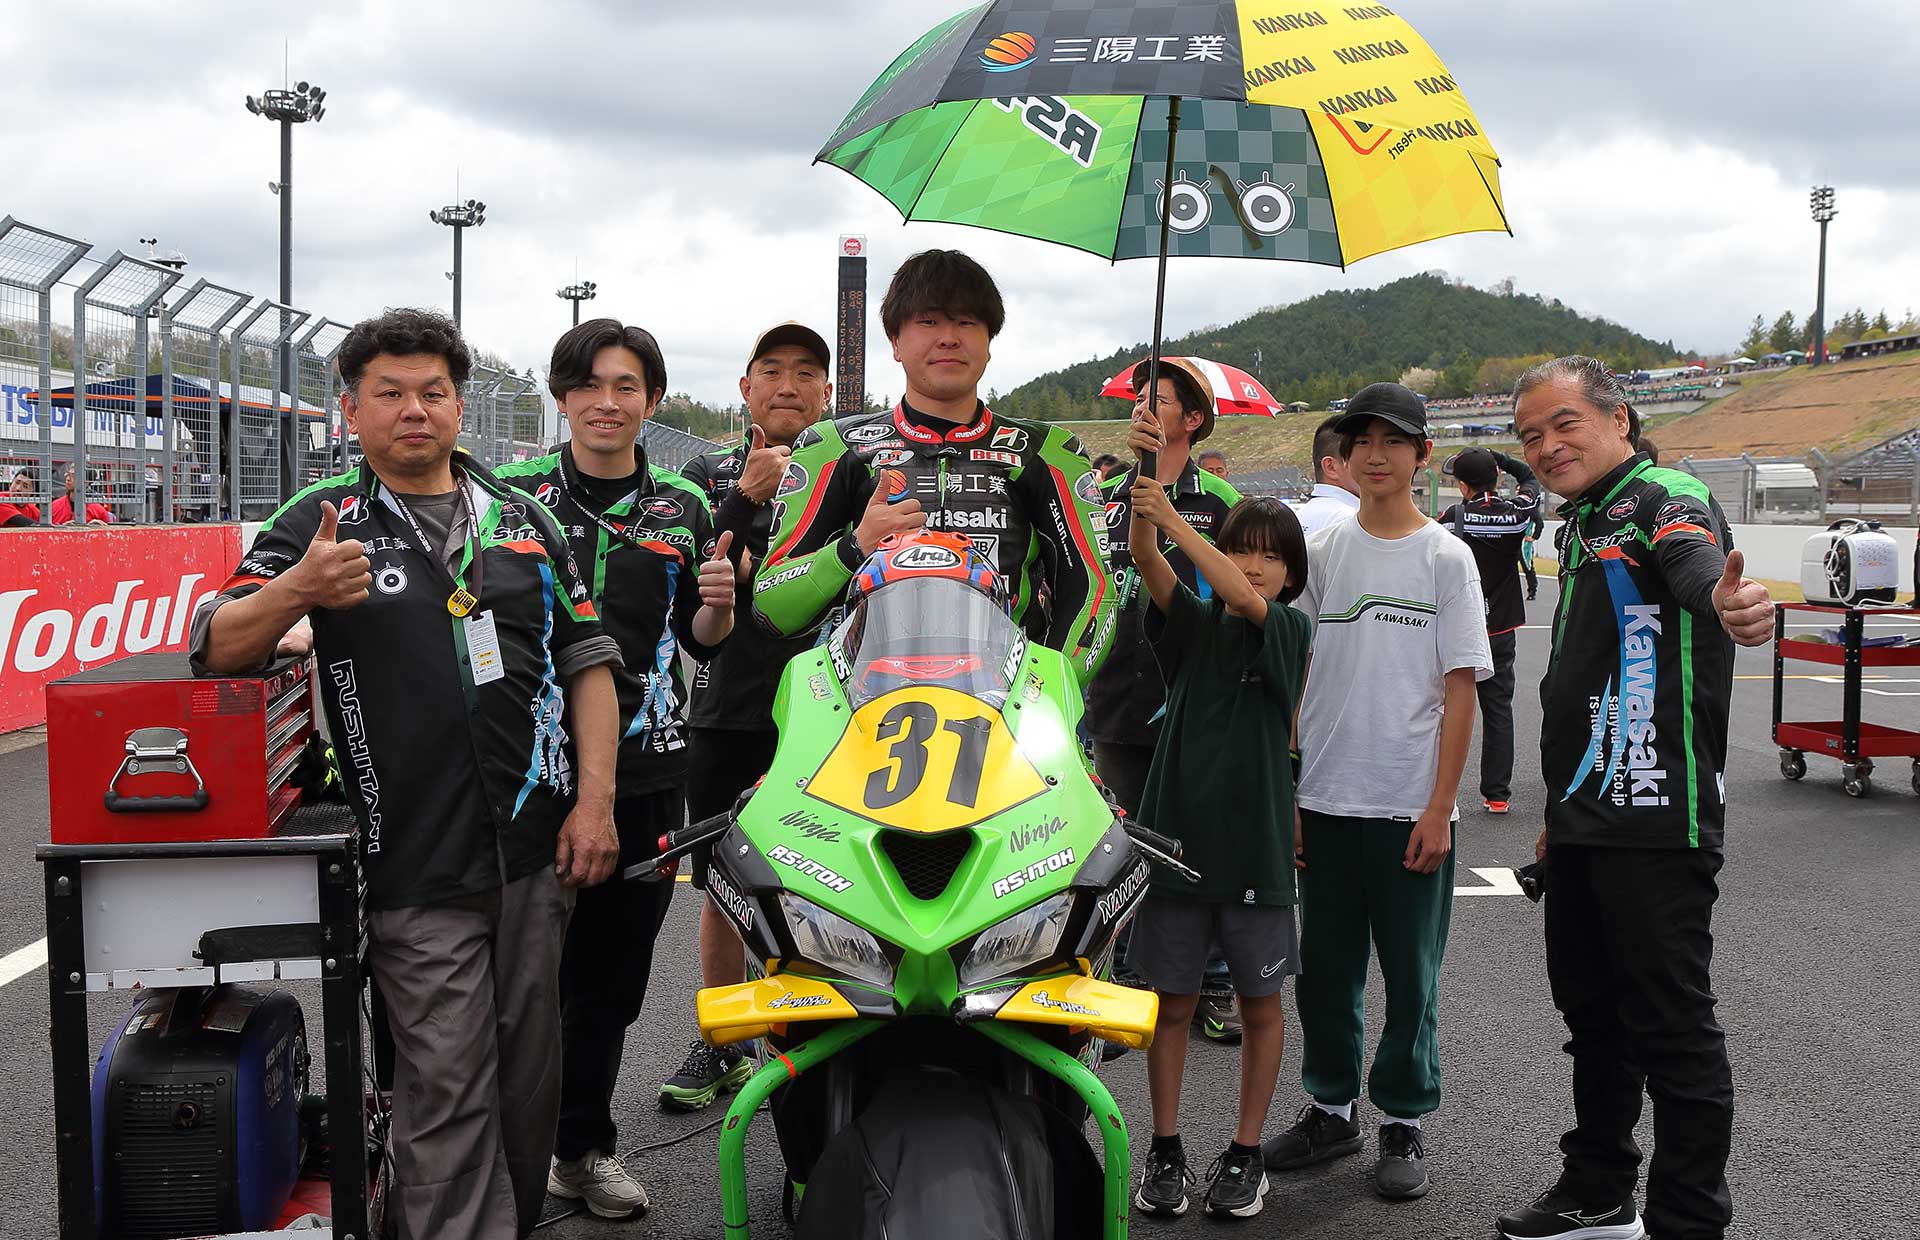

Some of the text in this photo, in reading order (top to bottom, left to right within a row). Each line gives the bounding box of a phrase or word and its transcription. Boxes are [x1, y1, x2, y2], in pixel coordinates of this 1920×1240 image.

[1252, 10, 1328, 36] NANKAI
[1049, 35, 1227, 63] 三陽工業
[1332, 39, 1409, 66] NANKAI
[1243, 55, 1317, 92] NANKAI
[1318, 85, 1398, 117] NANKAI
[973, 451, 1020, 466] BEET
[916, 472, 1008, 496] 三陽工業
[924, 507, 1007, 529] wasaki
[1463, 512, 1517, 523] USHITANI
[897, 548, 952, 564] Arai
[756, 561, 813, 593] RS-ITOH
[1374, 611, 1428, 629] KAWASAKI
[828, 638, 850, 680] WRS
[1003, 634, 1026, 681] WRS
[1624, 604, 1670, 806] Kawasaki
[1589, 696, 1605, 772] rs-itoh.com
[863, 701, 990, 809] 31
[778, 810, 841, 843] Ninja
[1010, 814, 1069, 853] Ninja
[768, 844, 854, 892] RS-ITOH
[992, 848, 1075, 899] RS-ITOH
